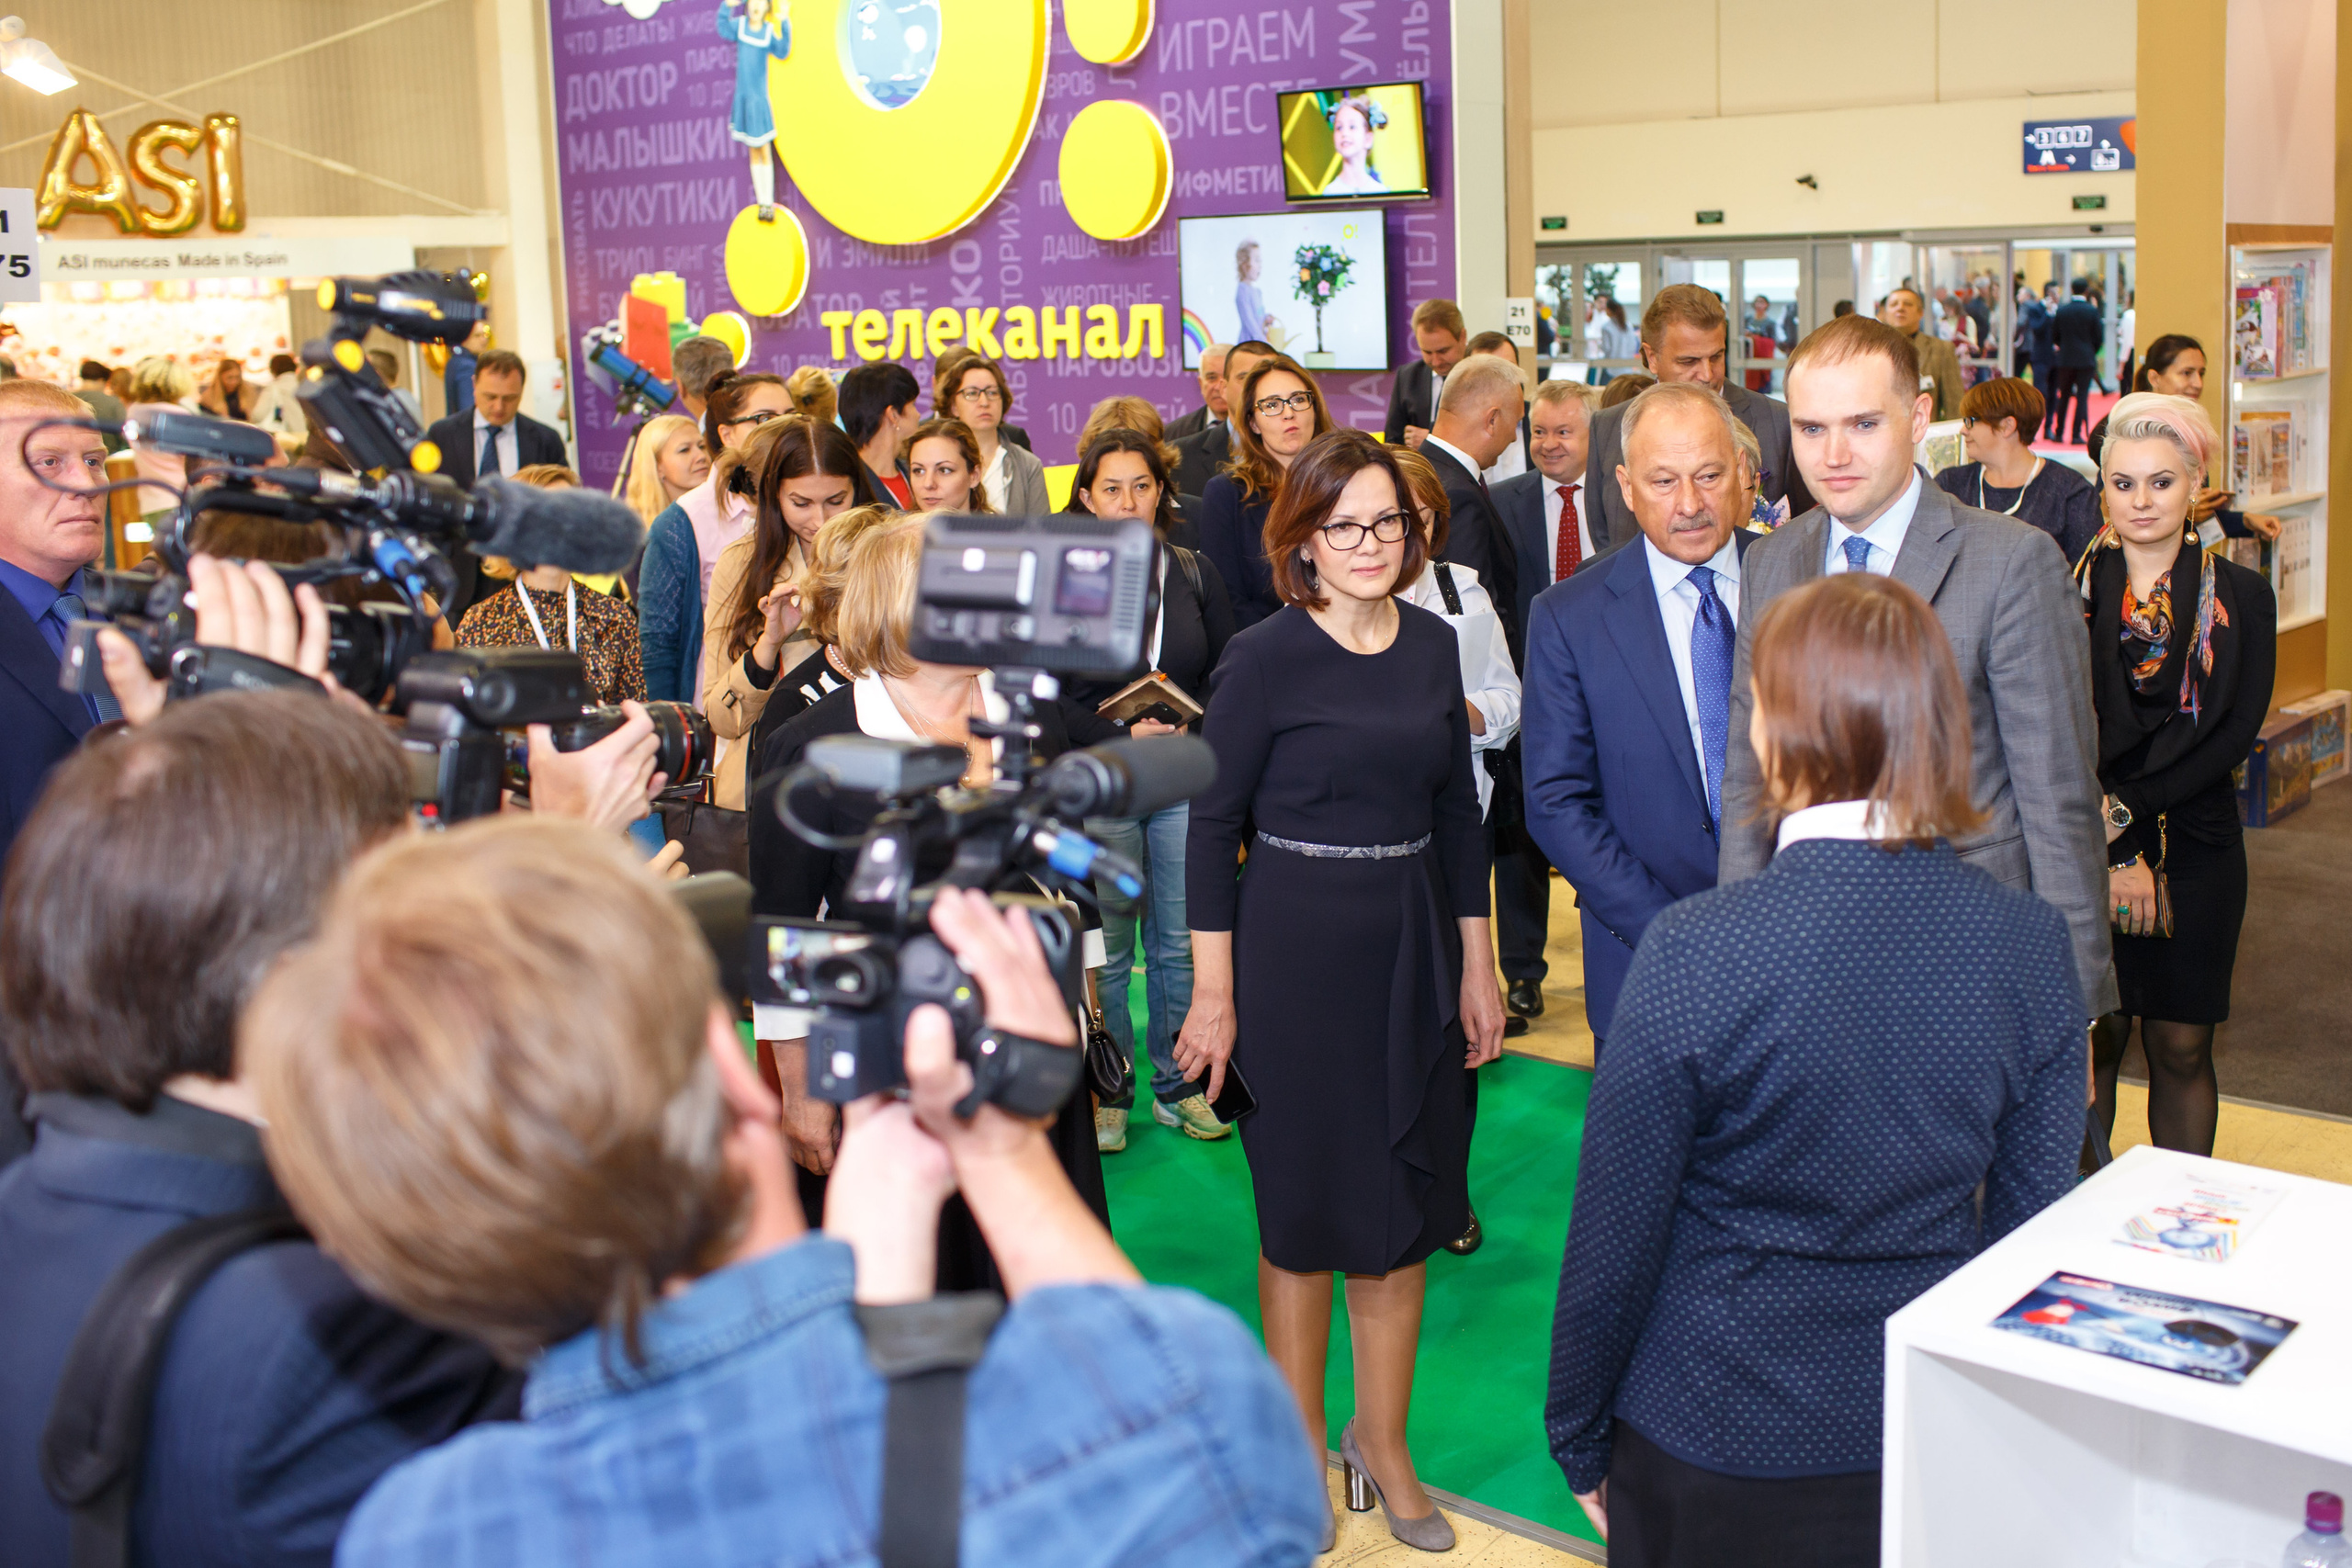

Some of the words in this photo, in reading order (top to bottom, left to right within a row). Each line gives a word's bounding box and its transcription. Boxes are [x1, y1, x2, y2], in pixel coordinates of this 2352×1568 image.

[563, 30, 596, 55] ЧТО
[1157, 6, 1315, 73] ИГРАЕМ
[565, 61, 678, 123] ДОКТОР
[1159, 79, 1317, 141] ВМЕС
[37, 107, 246, 237] ASI
[1175, 164, 1284, 199] ИФМЕТИ
[591, 176, 741, 231] КУКУТИКИ
[58, 254, 88, 269] ASI
[93, 256, 170, 270] munecas
[177, 253, 220, 267] Made
[225, 252, 240, 266] in
[243, 252, 289, 269] Spain
[1041, 283, 1153, 310] ЖИВОТНЫЕ
[1510, 306, 1525, 317] 21
[820, 303, 1165, 361] телеканал
[1507, 324, 1531, 336] E70
[1047, 401, 1077, 434] 10
